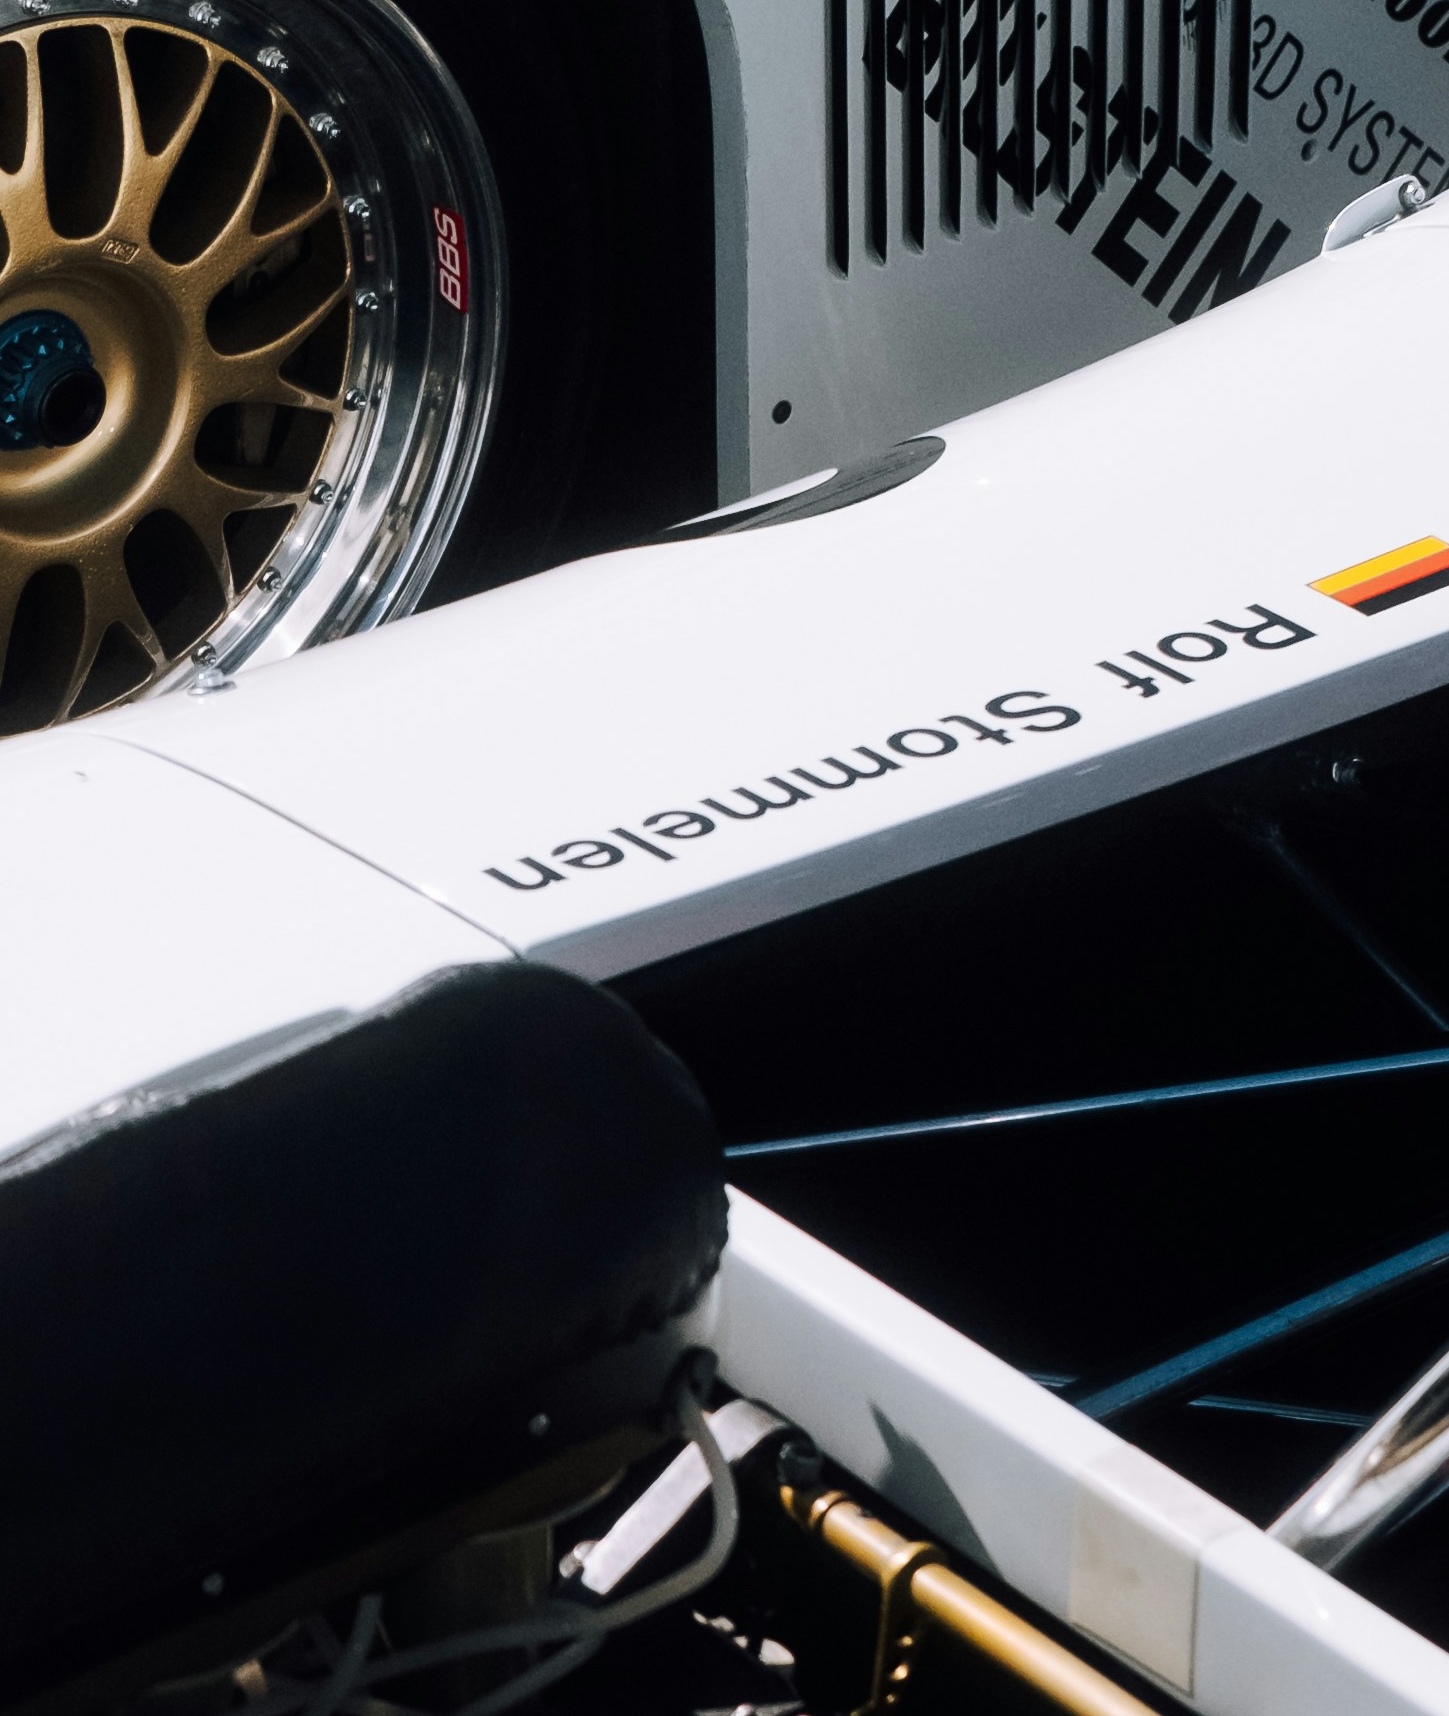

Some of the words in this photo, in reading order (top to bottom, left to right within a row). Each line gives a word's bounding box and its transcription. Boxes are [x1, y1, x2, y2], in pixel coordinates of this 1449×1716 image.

[1296, 68, 1449, 198] SYSTE
[434, 207, 461, 310] BBS
[1095, 602, 1320, 699] Rolf
[481, 689, 1083, 892] Stommelen
